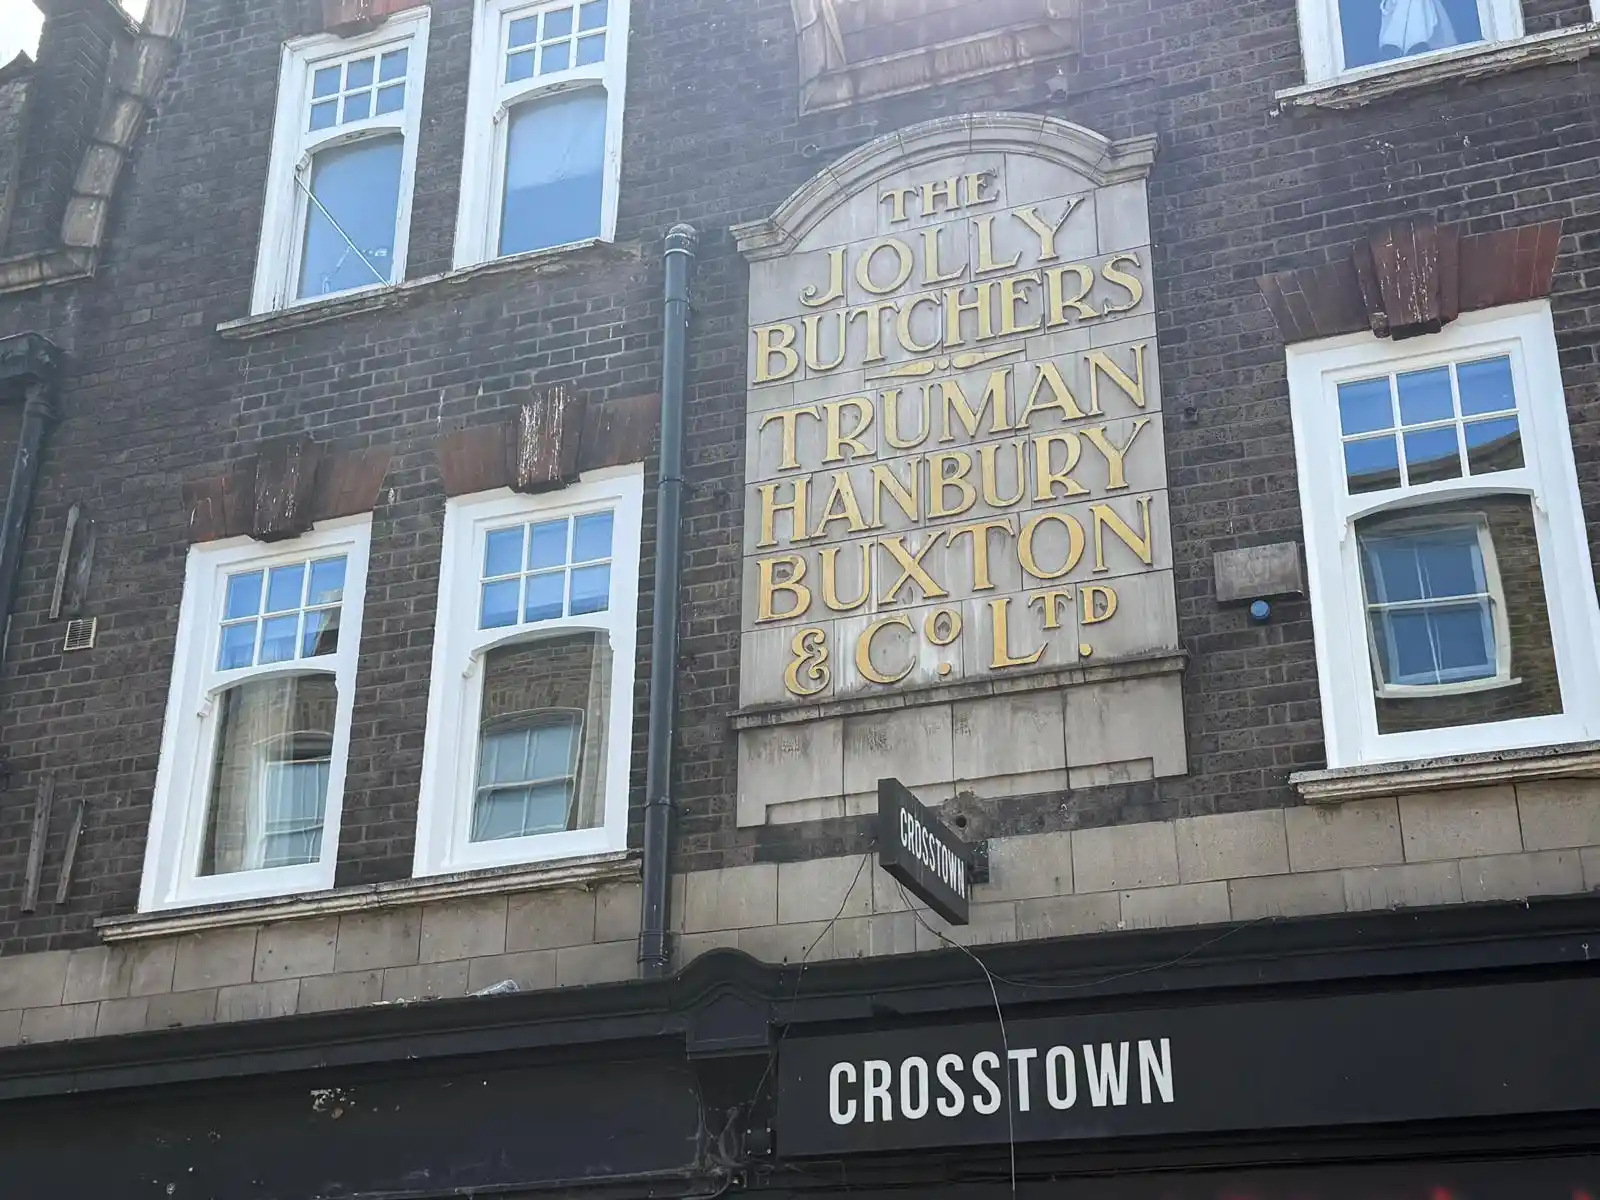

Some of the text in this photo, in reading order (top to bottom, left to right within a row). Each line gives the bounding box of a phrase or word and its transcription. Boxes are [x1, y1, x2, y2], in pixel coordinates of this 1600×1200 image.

[799, 196, 1085, 307] JOLLY
[880, 168, 1001, 224] THE
[752, 251, 1144, 385] BUTCHERS
[758, 343, 1148, 472] TRUMAN
[755, 417, 1151, 549] HANBURY
[754, 494, 1154, 625] BUXTON
[783, 627, 831, 696] &
[899, 806, 967, 900] CROSSTOWN
[828, 1037, 1175, 1126] CROSSTOWN
